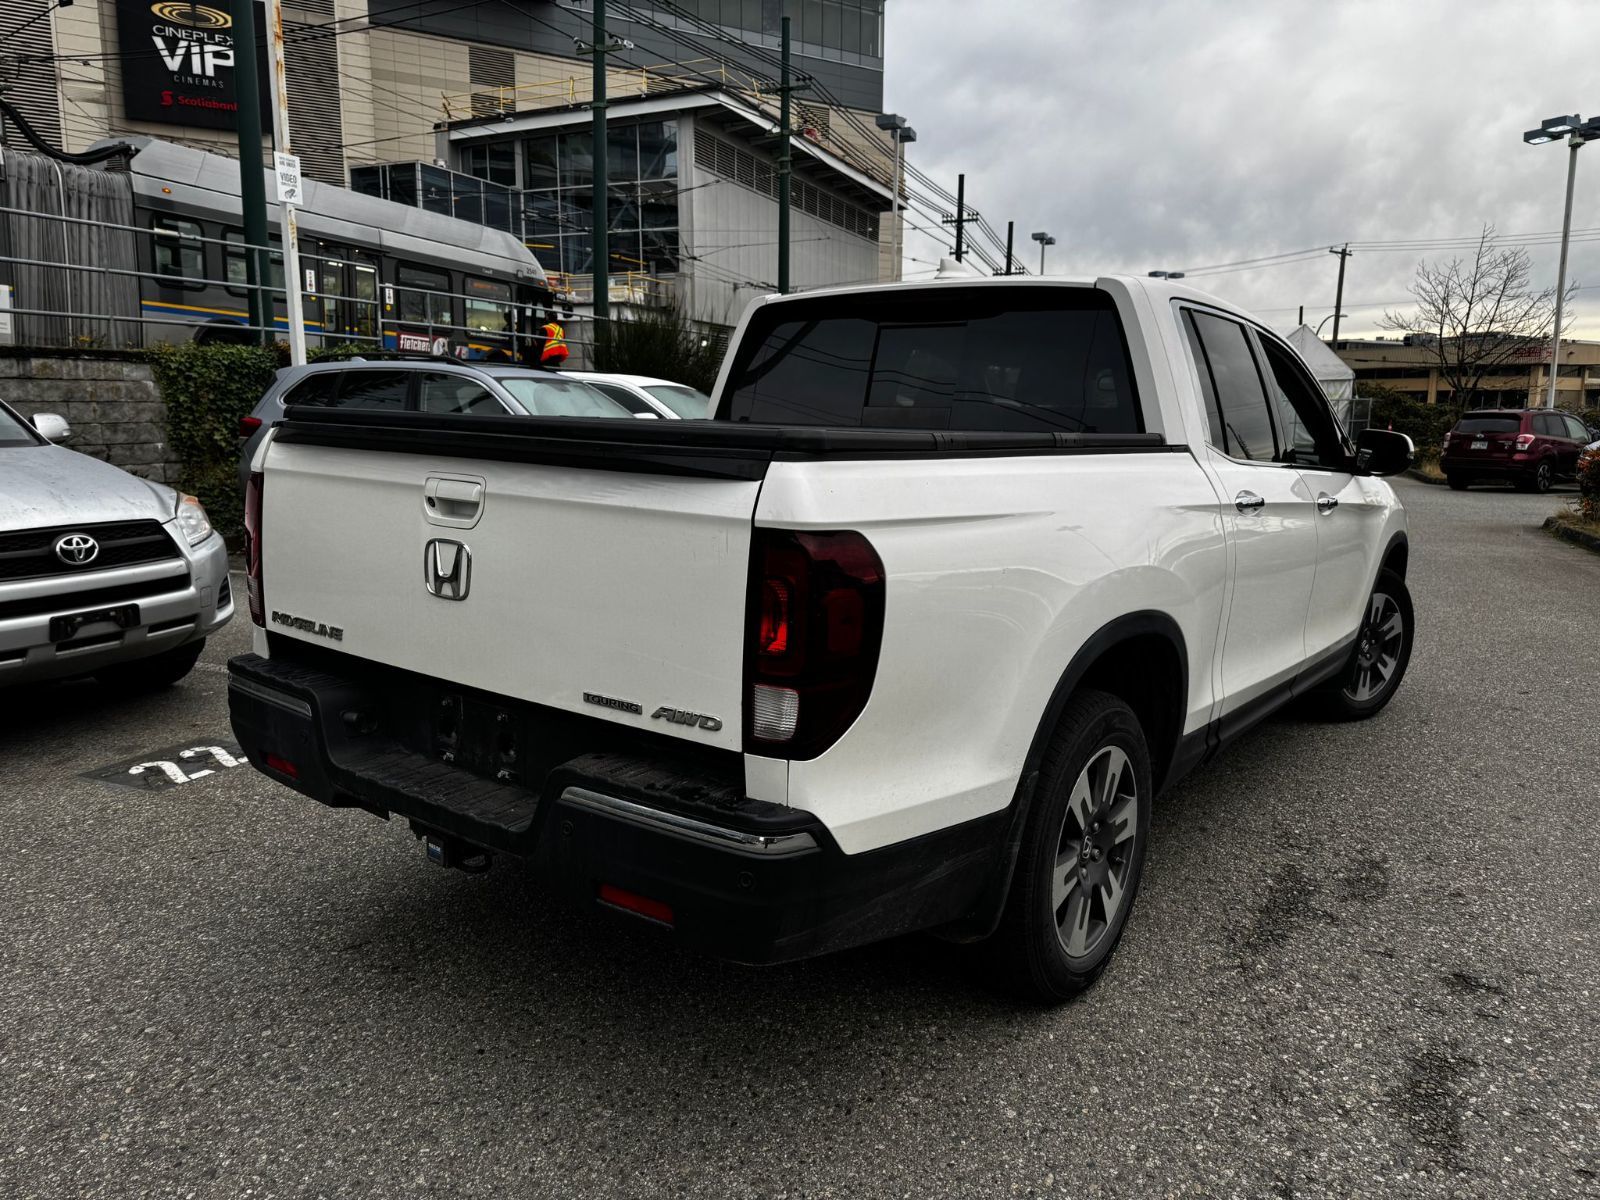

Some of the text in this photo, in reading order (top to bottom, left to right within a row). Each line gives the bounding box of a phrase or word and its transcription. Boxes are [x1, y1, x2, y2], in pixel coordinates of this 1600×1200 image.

[152, 25, 233, 45] CINEPLEX
[152, 35, 234, 77] VIP
[174, 74, 224, 89] CINEMAS
[585, 693, 640, 714] TOURING
[651, 706, 723, 731] AWD
[128, 745, 249, 784] 22
